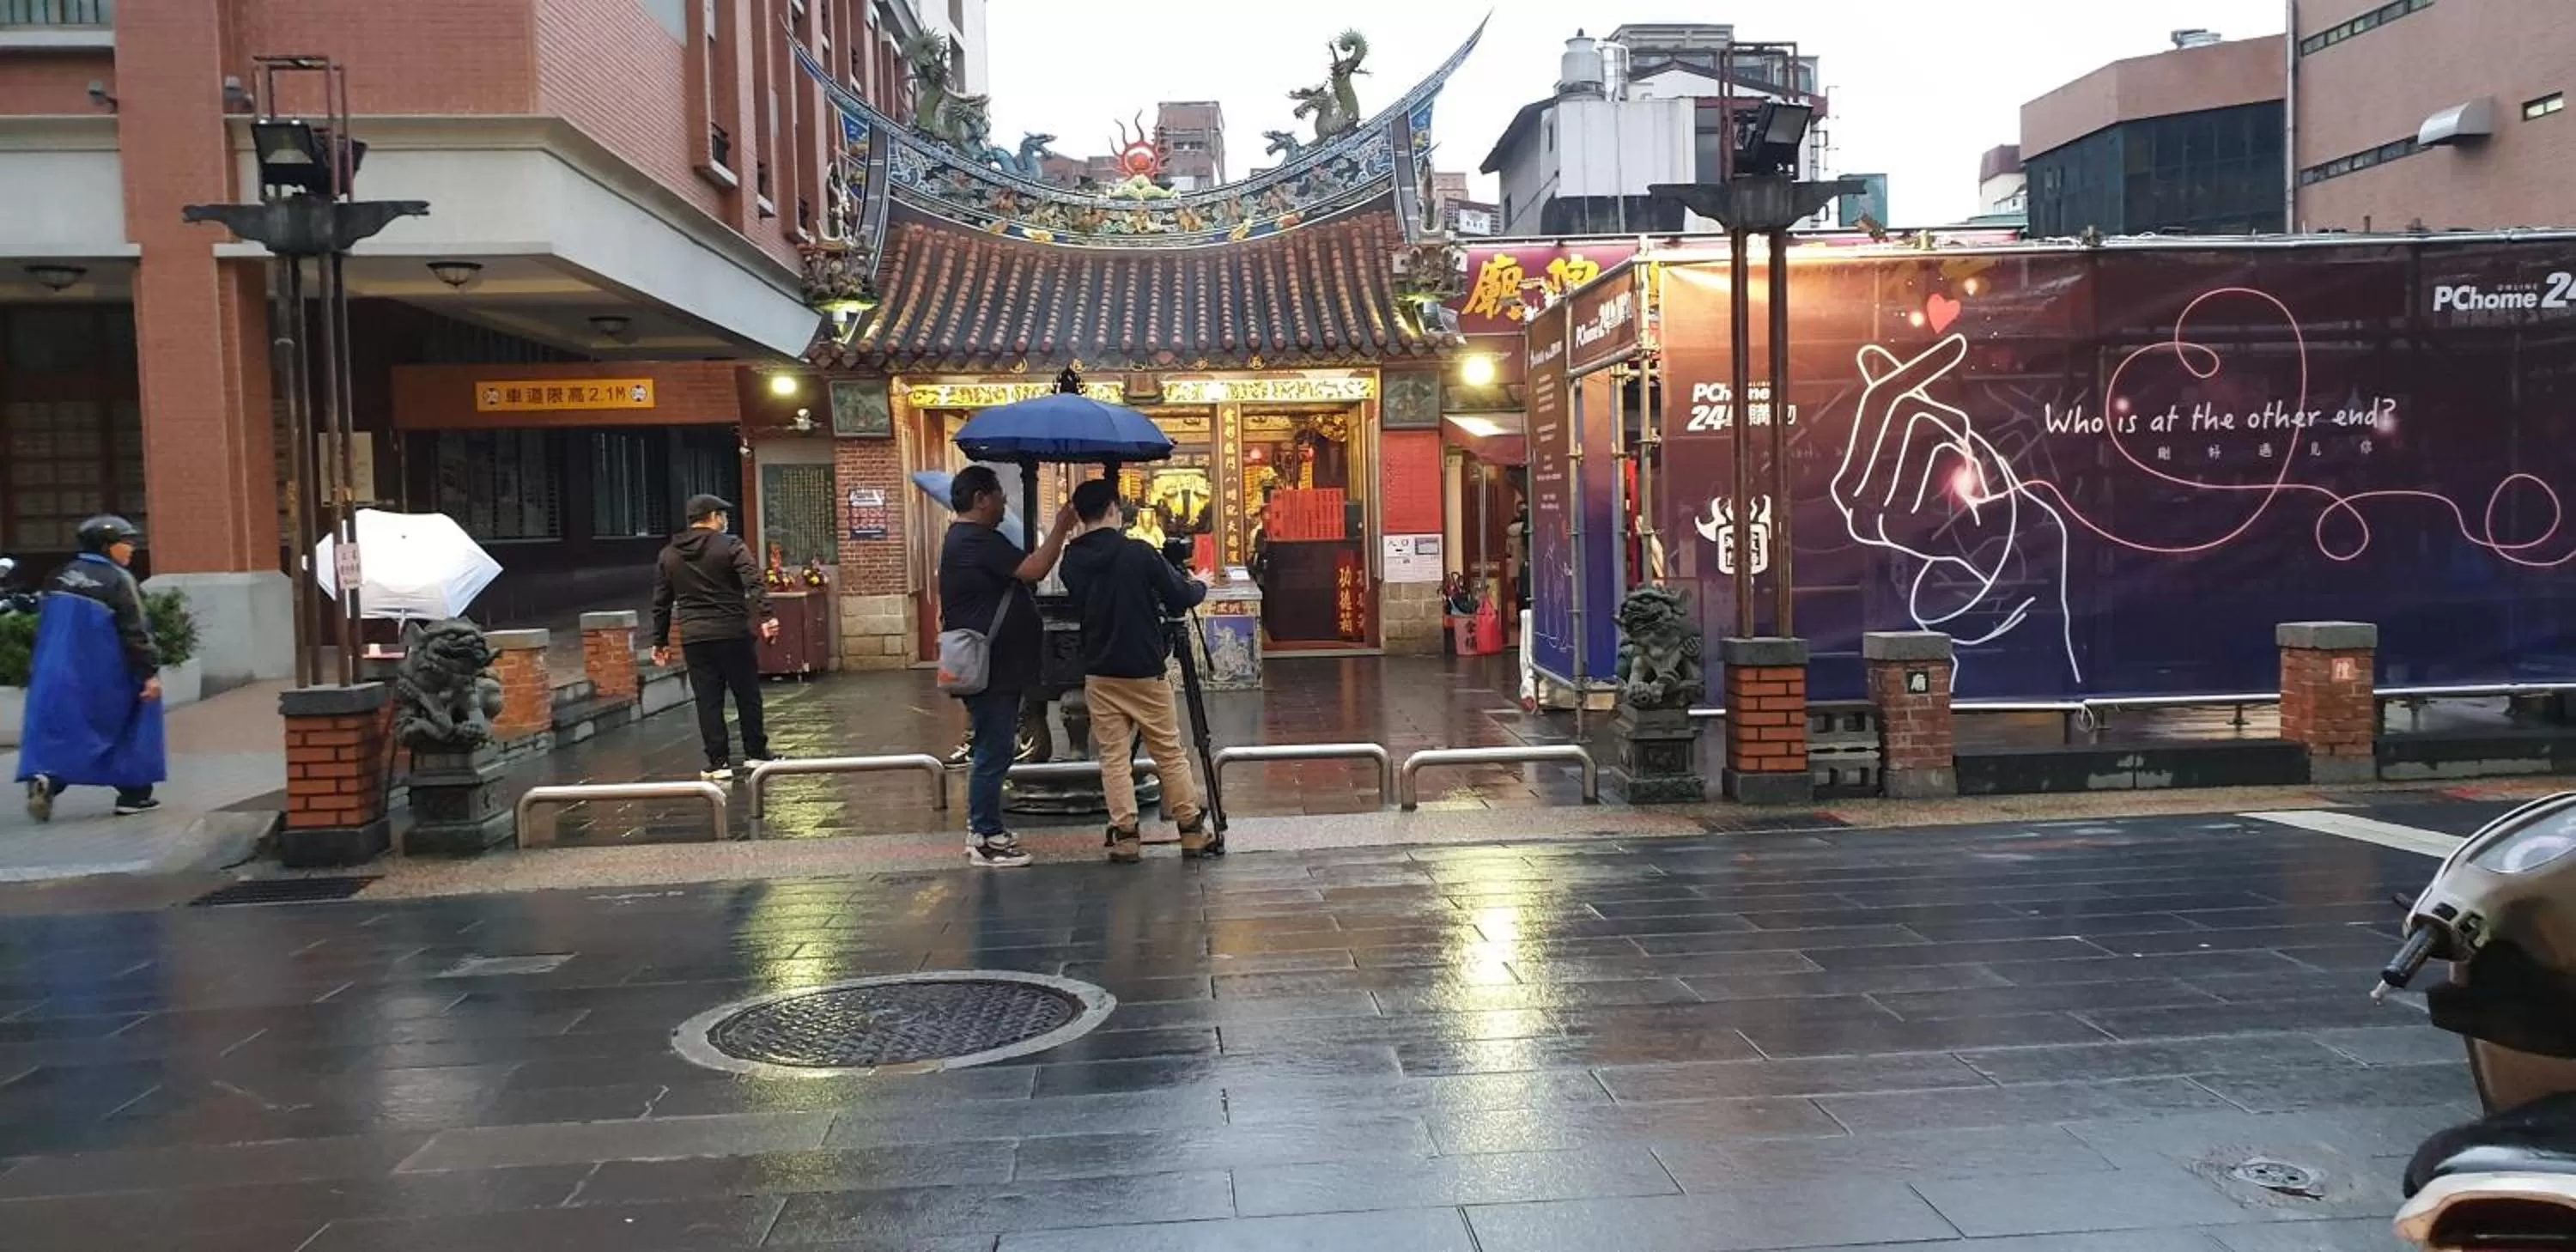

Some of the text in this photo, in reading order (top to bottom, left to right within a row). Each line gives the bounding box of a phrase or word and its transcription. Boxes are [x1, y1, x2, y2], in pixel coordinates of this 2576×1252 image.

[2433, 284, 2537, 312] PChome
[1692, 382, 1771, 403] PChme
[2044, 397, 2397, 434] Who is at the other end?
